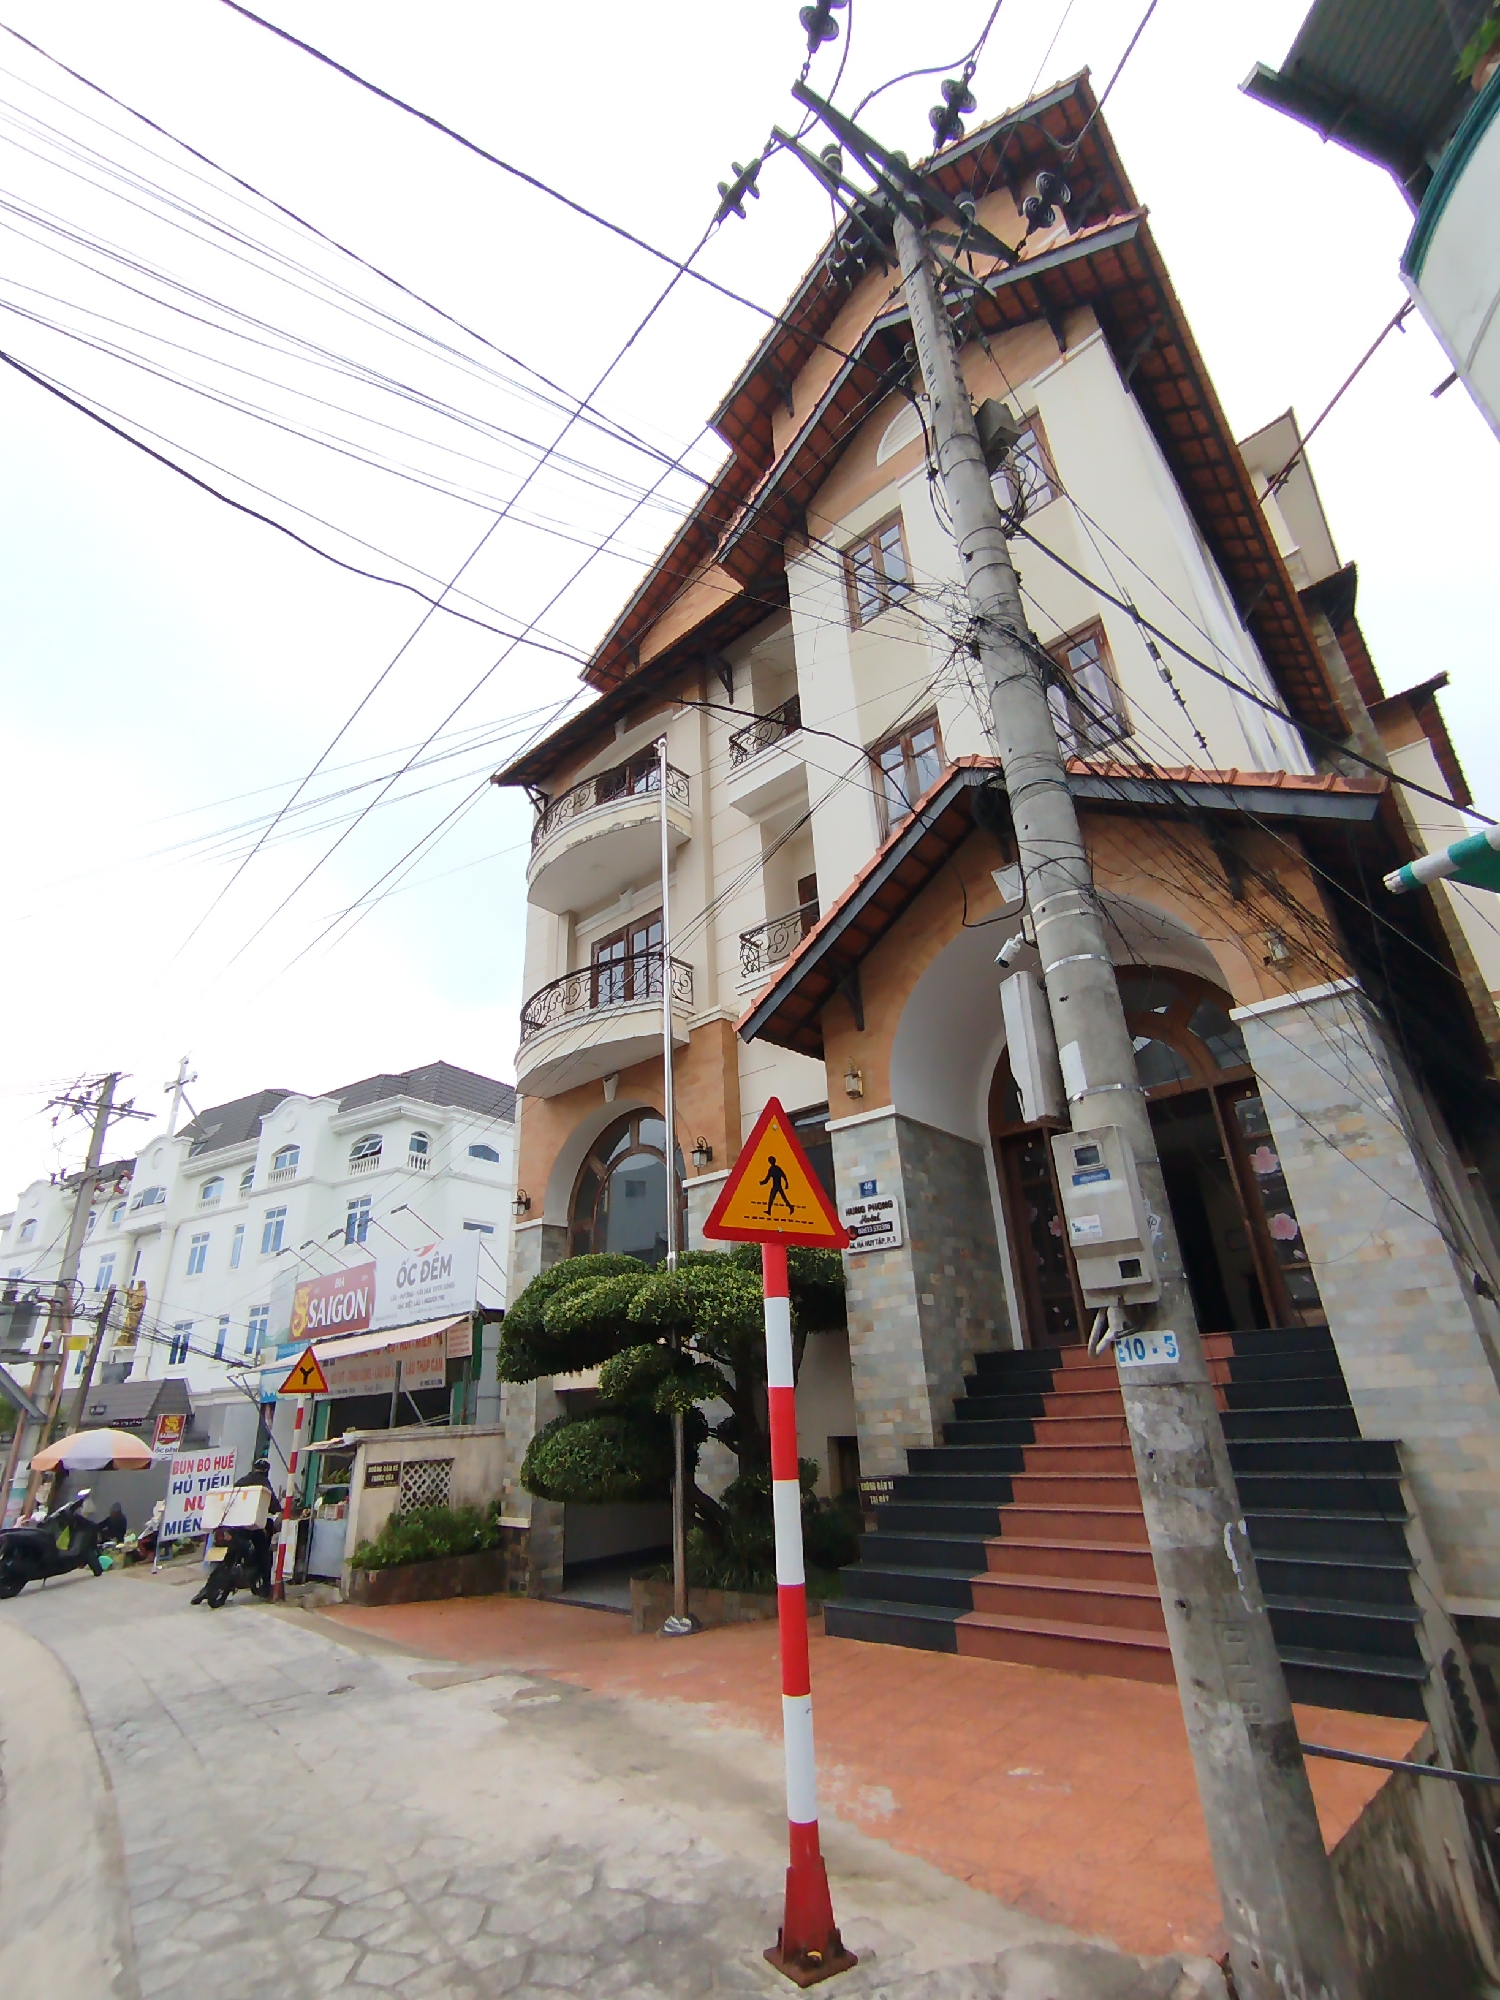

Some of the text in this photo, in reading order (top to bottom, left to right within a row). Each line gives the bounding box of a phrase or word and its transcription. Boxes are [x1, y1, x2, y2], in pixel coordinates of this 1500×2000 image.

[396, 1252, 453, 1289] ỐC ĐÊM
[308, 1287, 369, 1328] SAIGON
[172, 1455, 194, 1475] BÚN
[213, 1448, 235, 1470] HUẾ
[172, 1474, 193, 1495] HỦ
